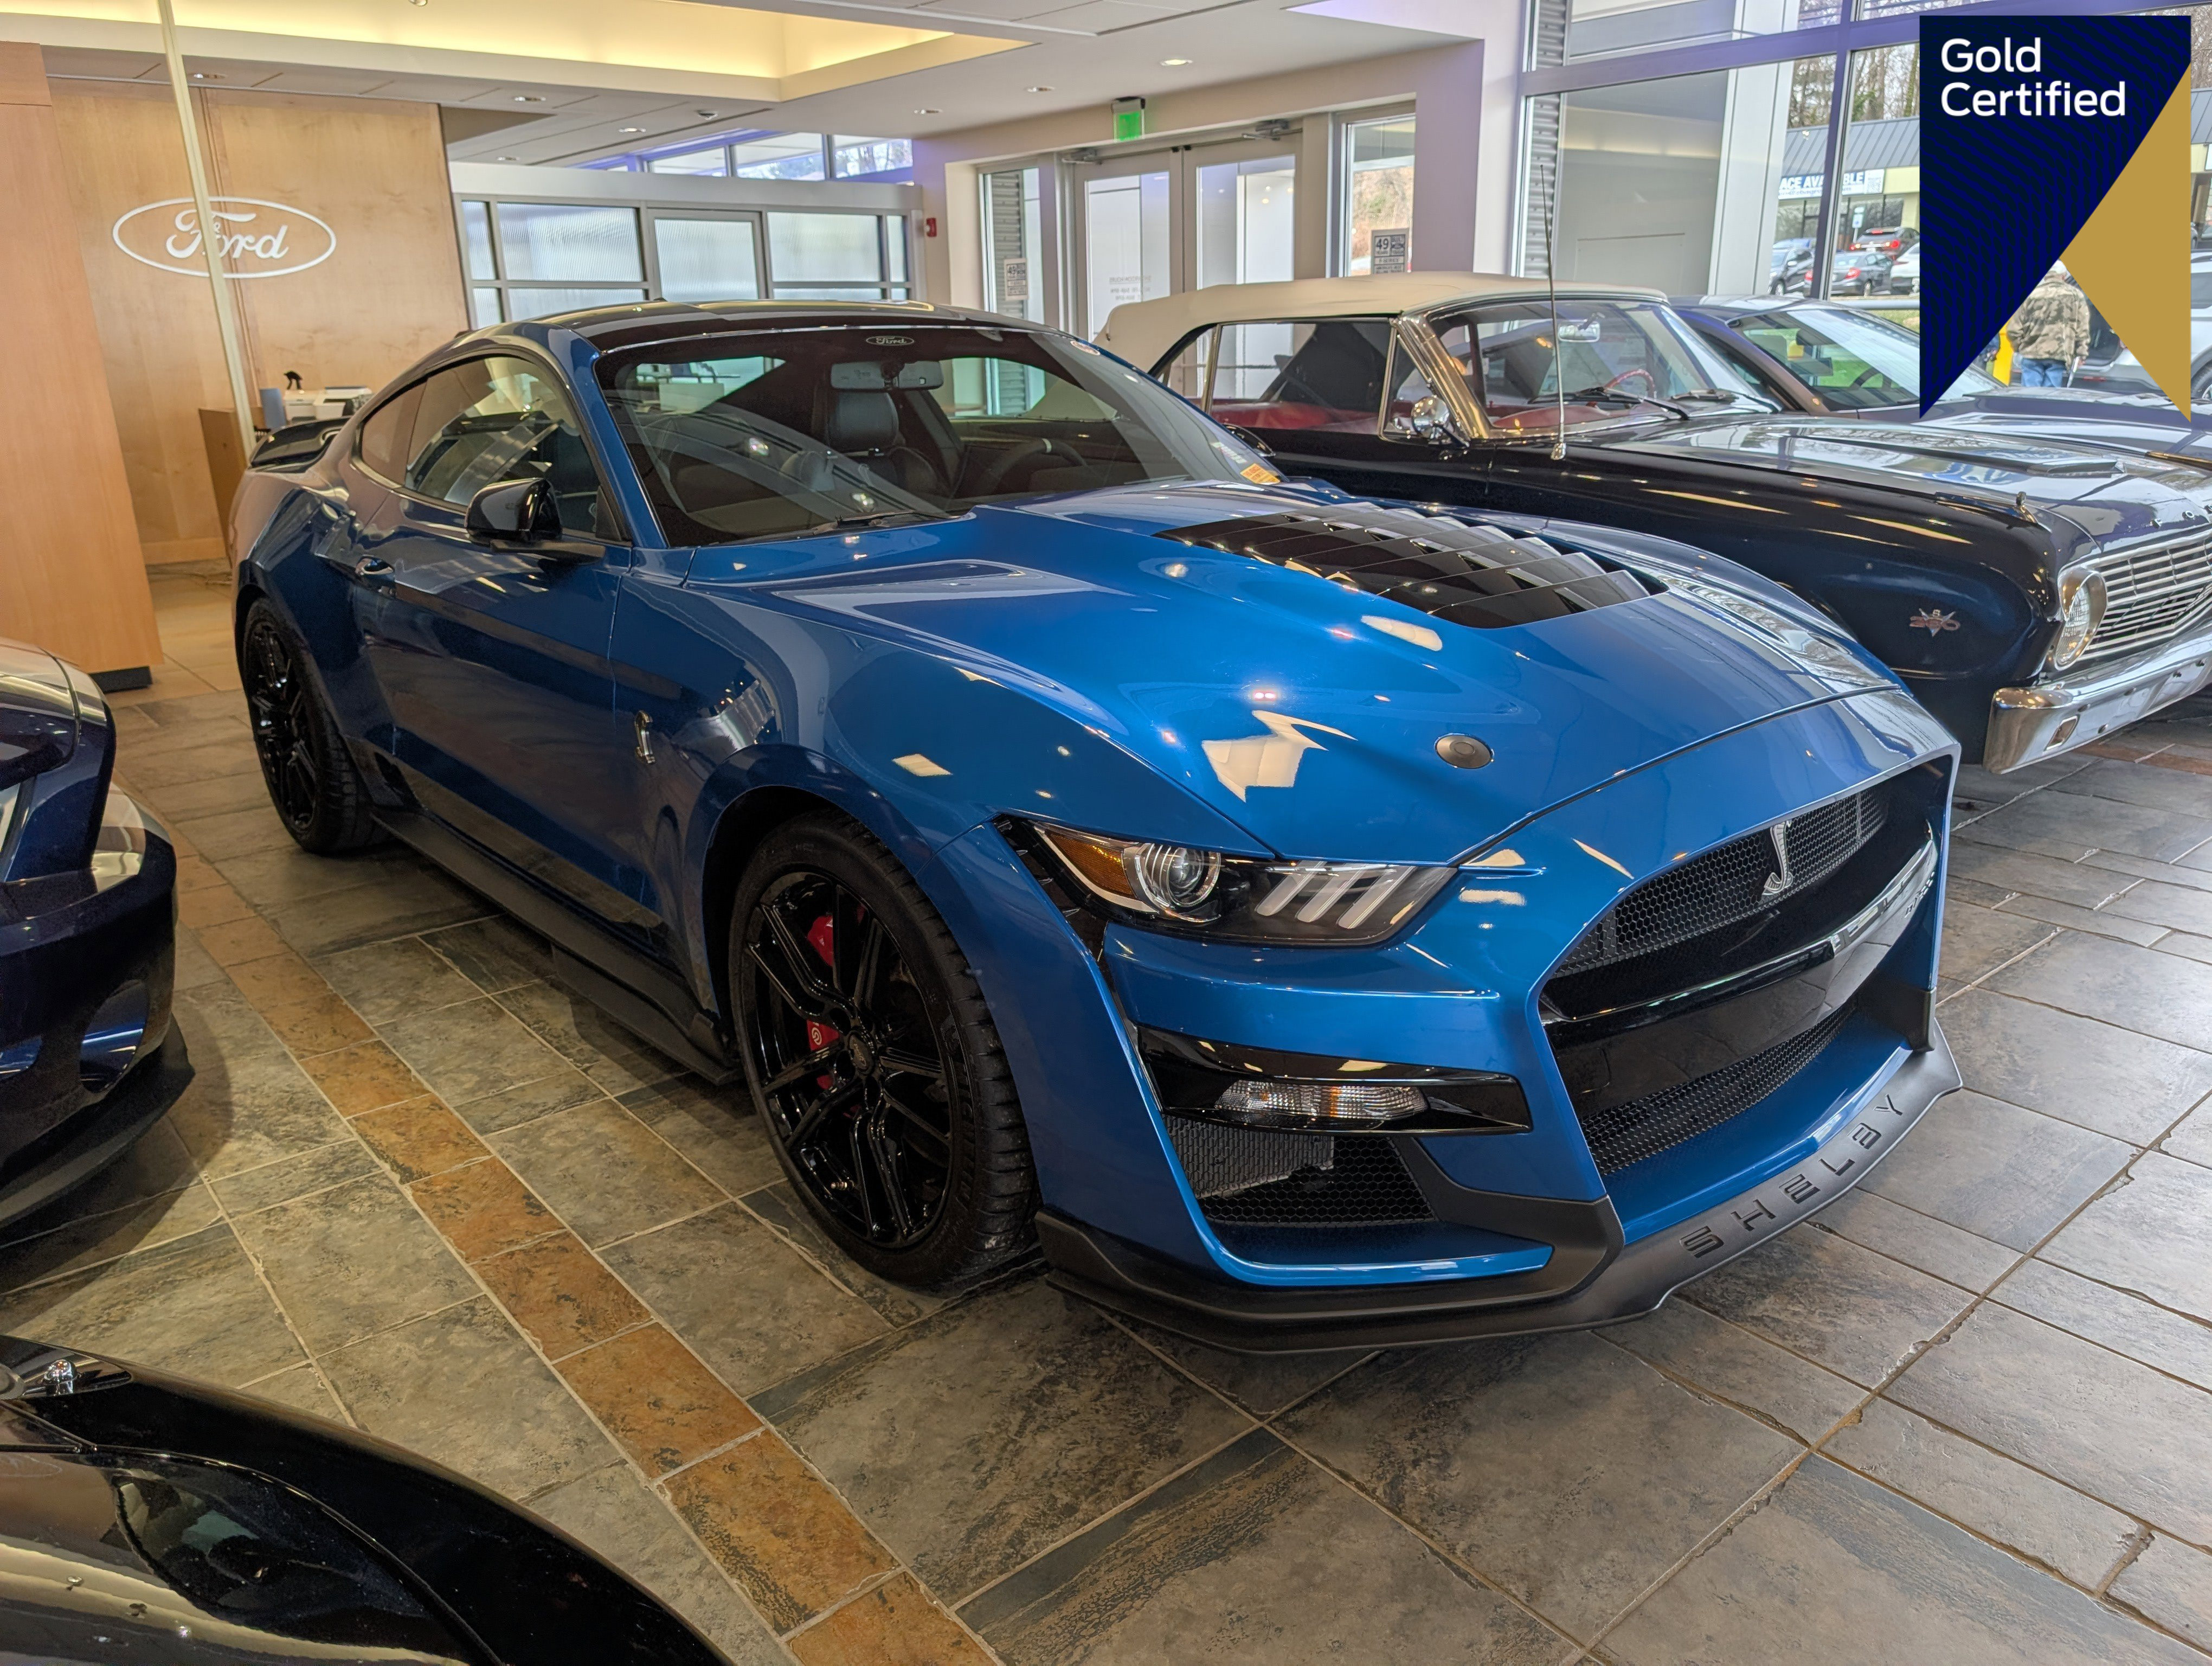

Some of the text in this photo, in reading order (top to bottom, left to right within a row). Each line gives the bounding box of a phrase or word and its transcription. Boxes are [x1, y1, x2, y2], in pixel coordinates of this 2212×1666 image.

[1779, 177, 1802, 190] ACE
[166, 208, 290, 259] Ford
[1376, 238, 1389, 250] 49
[876, 336, 907, 344] Ford
[1679, 1094, 1904, 1258] SHELBY
